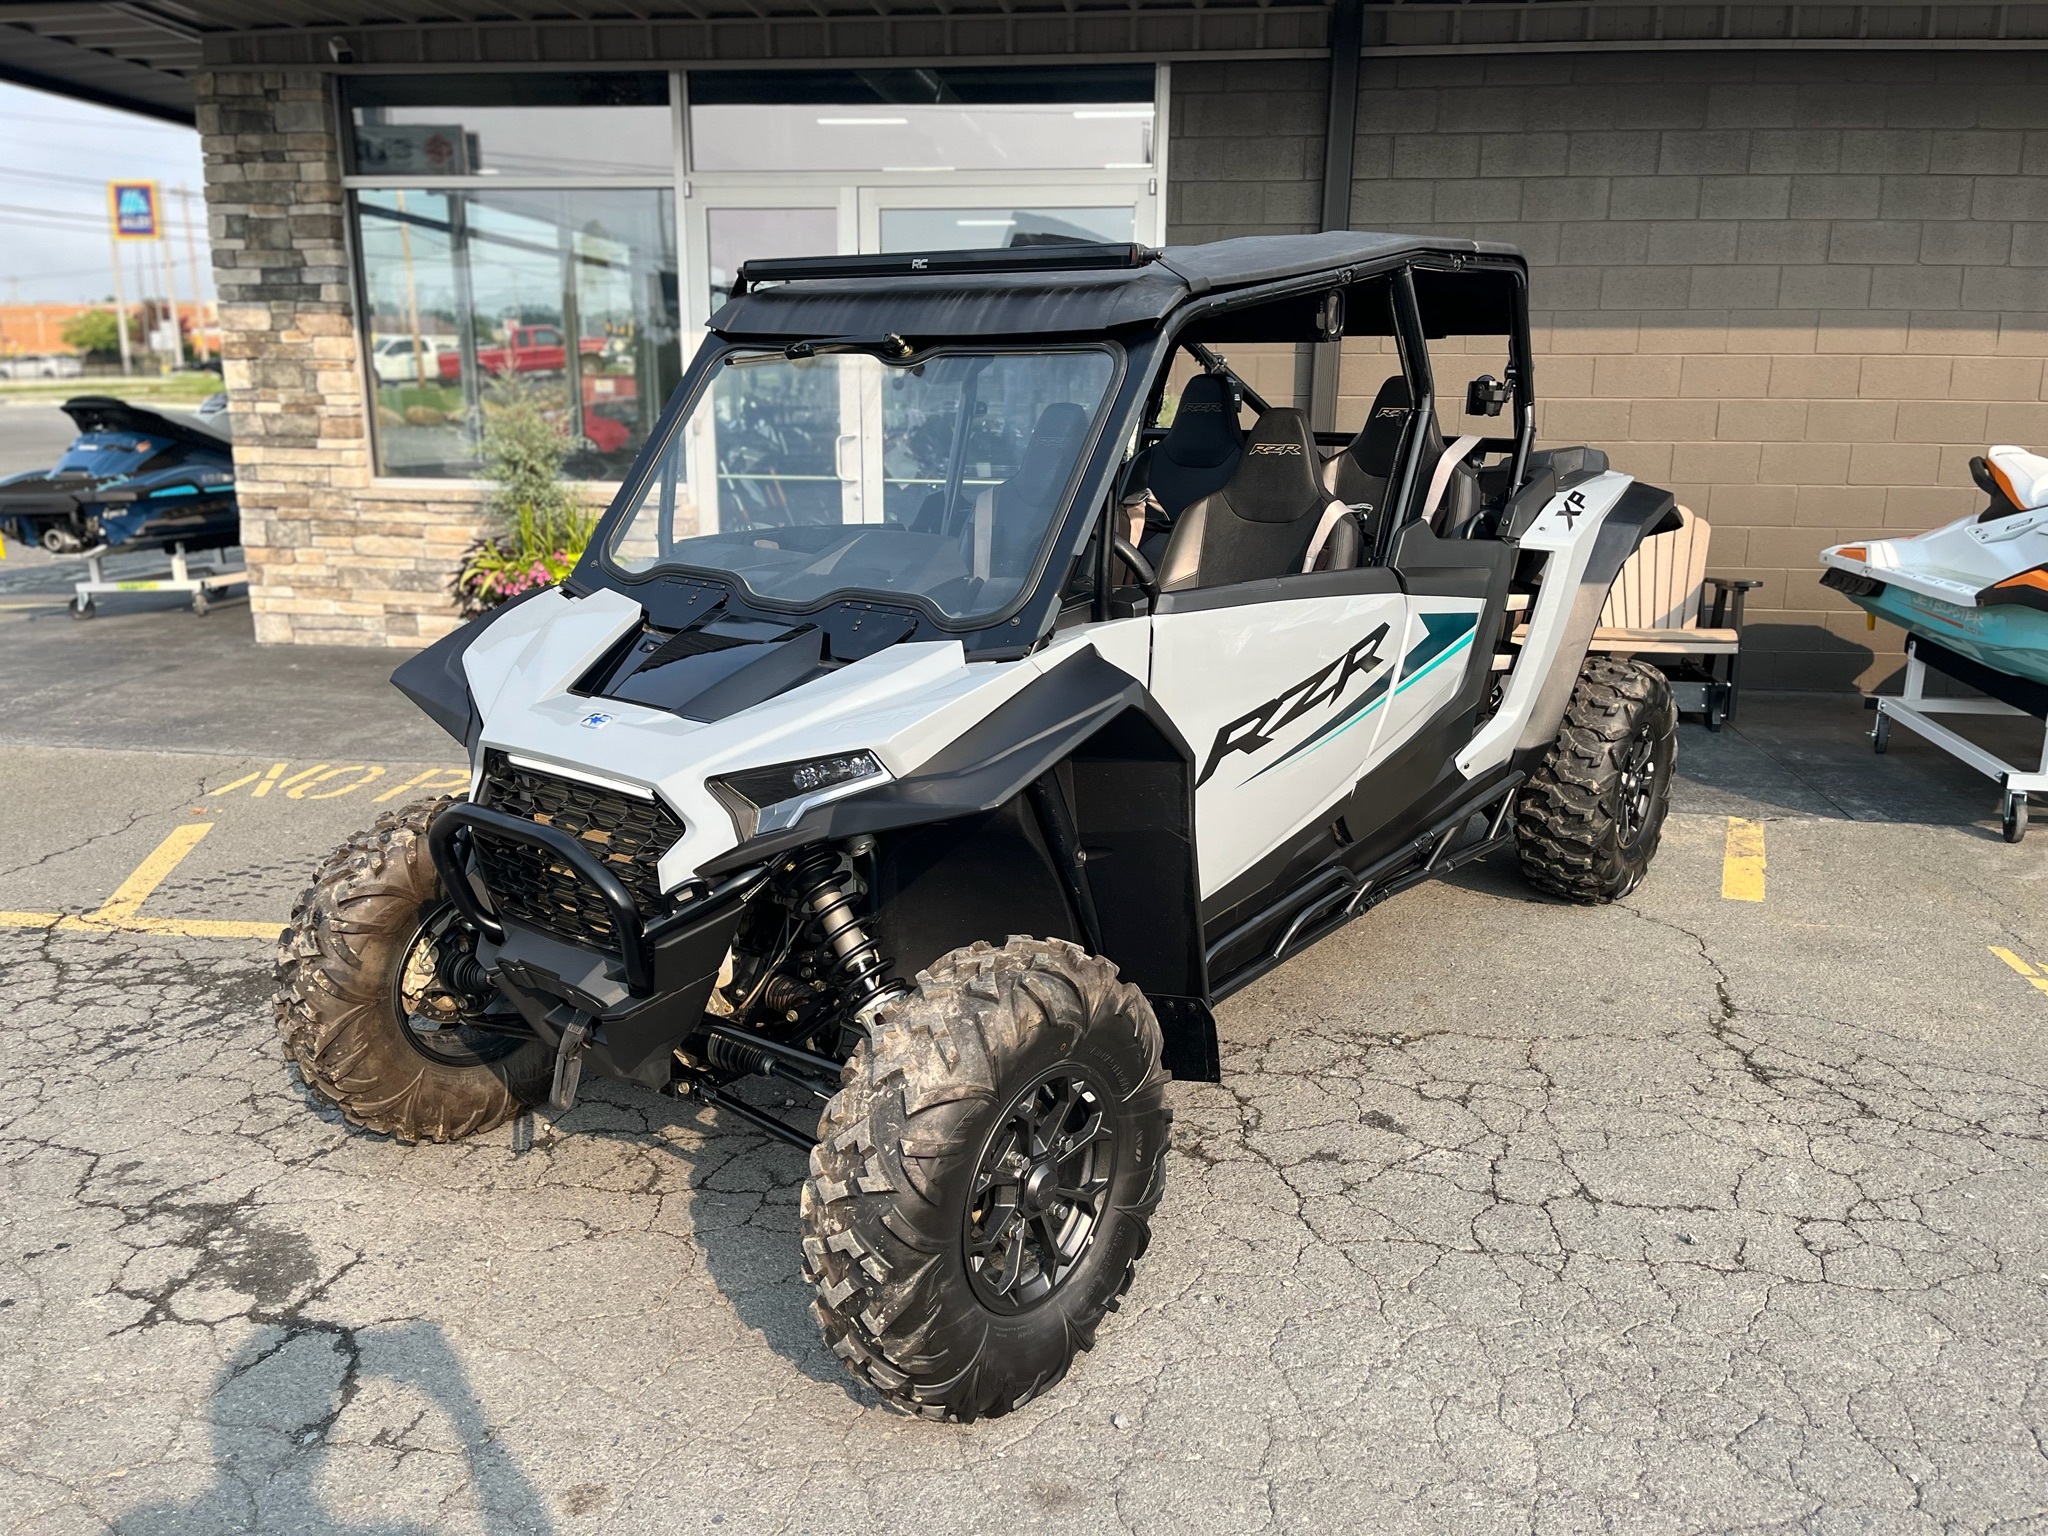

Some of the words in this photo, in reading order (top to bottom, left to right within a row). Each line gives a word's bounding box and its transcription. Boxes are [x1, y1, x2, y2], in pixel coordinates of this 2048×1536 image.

[911, 258, 929, 270] RC
[1182, 402, 1223, 413] RZR
[1248, 443, 1301, 456] RZR
[1555, 490, 1586, 532] XP
[1195, 621, 1391, 791] RZR
[207, 763, 386, 799] NO
